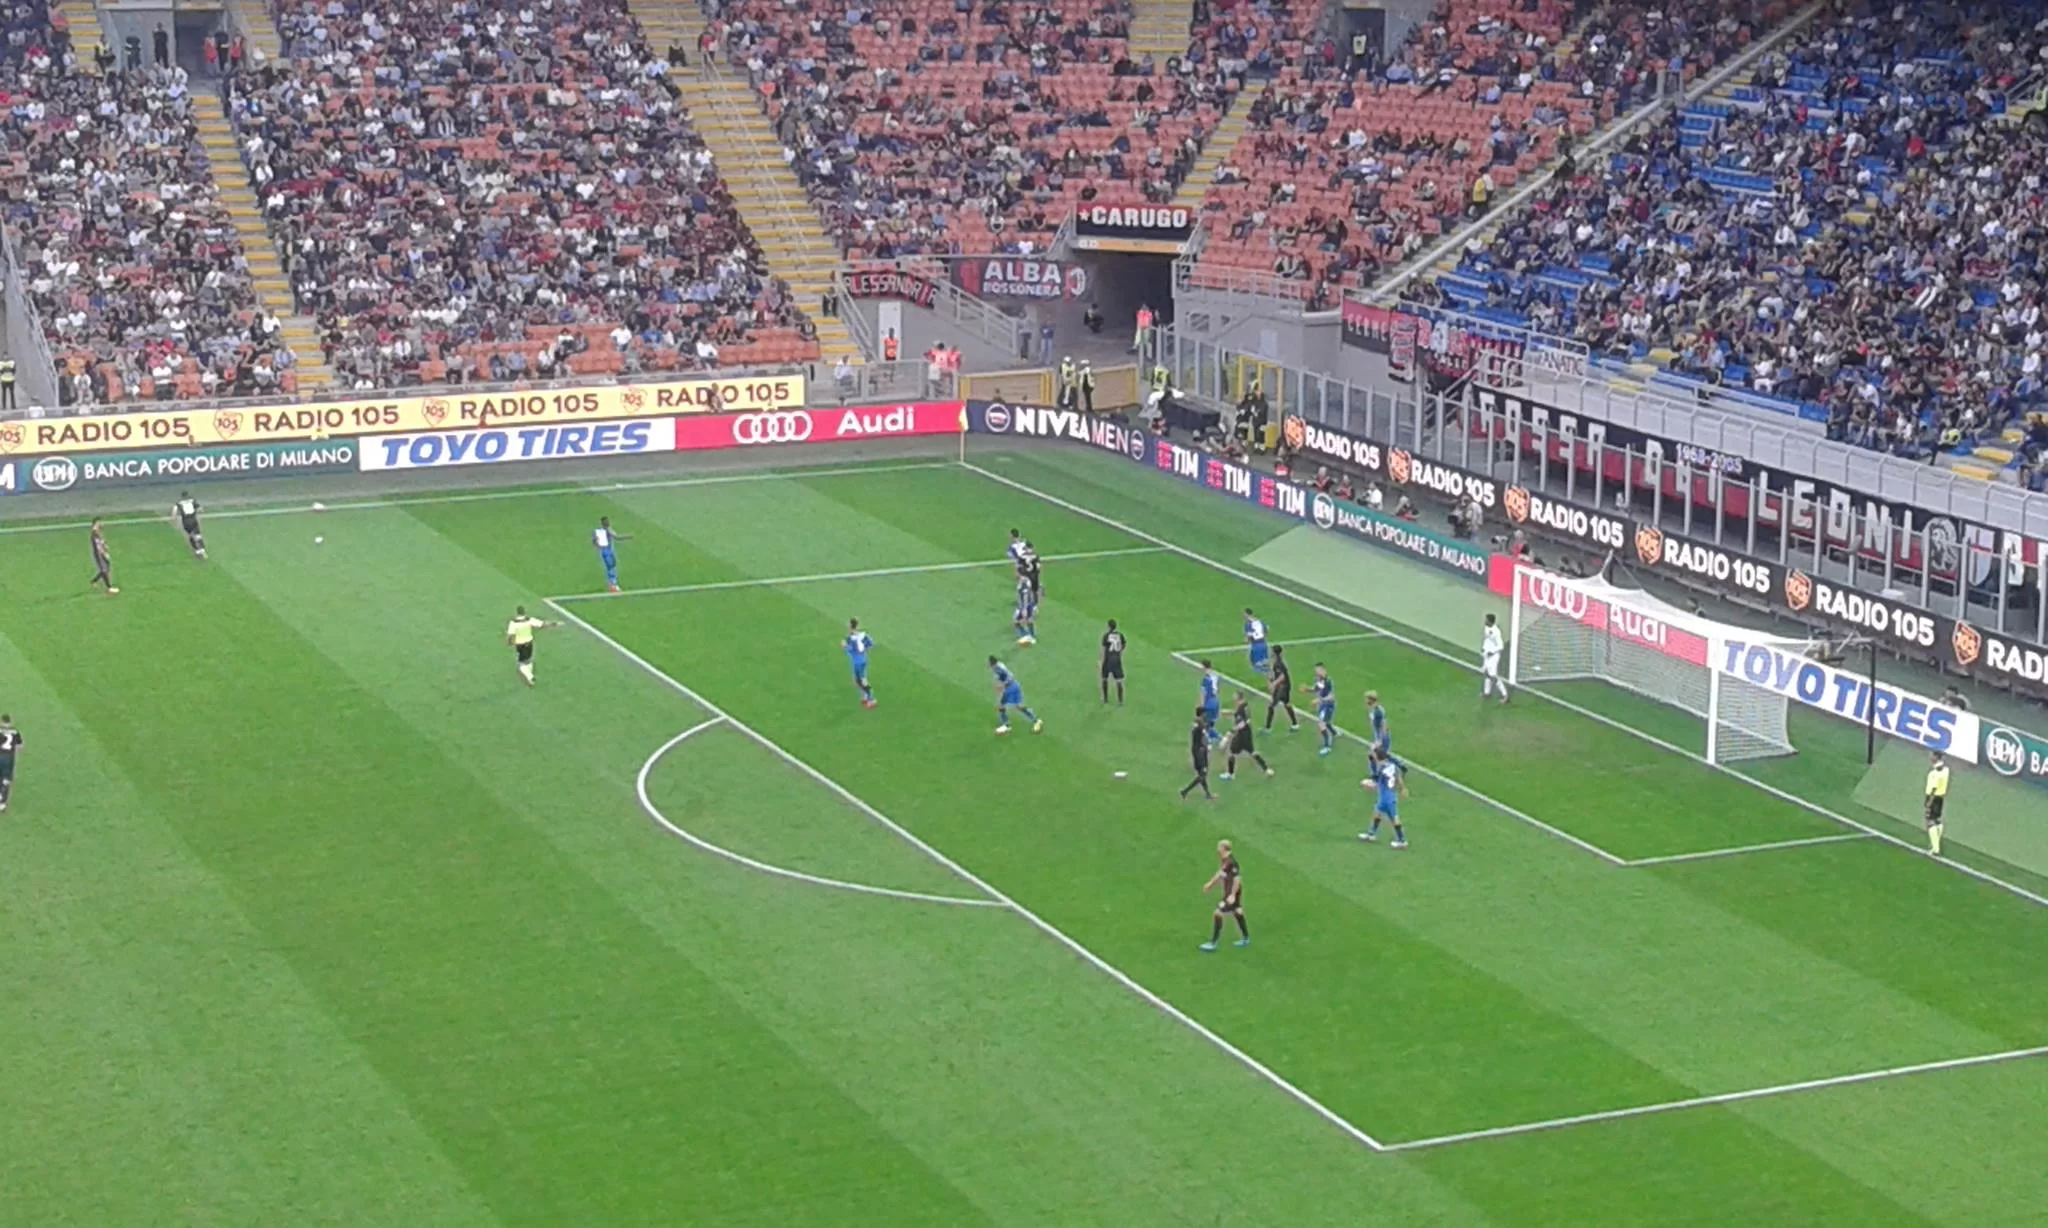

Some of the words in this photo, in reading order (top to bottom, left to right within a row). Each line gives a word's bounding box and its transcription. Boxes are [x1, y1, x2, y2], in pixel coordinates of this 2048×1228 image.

[1092, 206, 1188, 228] CARUGO
[983, 281, 1061, 296] ROSSONERA
[984, 261, 1062, 283] ALBA
[461, 397, 546, 420] RADIO
[554, 394, 599, 413] 105
[657, 385, 739, 407] RADO
[747, 382, 789, 402] 105
[38, 421, 132, 445] RADIO
[140, 418, 191, 439] 105
[255, 408, 344, 432] RADIO
[351, 405, 399, 426] 105
[837, 407, 914, 435] Audi
[1015, 406, 1089, 442] NIVEA
[1091, 417, 1129, 454] MEN
[382, 431, 509, 467] TOYO
[518, 422, 652, 456] TIRES
[1172, 445, 1199, 479] TIM
[1304, 426, 1350, 460] RADIO
[1353, 441, 1380, 470] 105
[84, 459, 152, 480] BANCA
[158, 452, 250, 474] POPOLARE
[256, 451, 274, 468] DI
[280, 447, 352, 467] MILANO
[1224, 463, 1251, 498] TIM
[1276, 482, 1305, 517] TIM
[1412, 462, 1463, 496] RADIO
[1465, 476, 1496, 507] 105
[1530, 497, 1588, 536] RADIO
[1590, 516, 1625, 549] 105
[1759, 470, 1913, 560] LEONI
[1337, 509, 1373, 536] BANCA
[1376, 522, 1426, 555] POPOLARE
[1428, 540, 1440, 558] DI
[1442, 544, 1486, 575] MILANO
[1664, 538, 1730, 580] RADIO
[1733, 558, 1771, 593] 105
[1610, 603, 1667, 646] Audi
[1816, 584, 1889, 632] RADIO
[1891, 608, 1935, 647] 105
[1724, 639, 1826, 704] TOYO
[1833, 673, 1957, 753] TIRES
